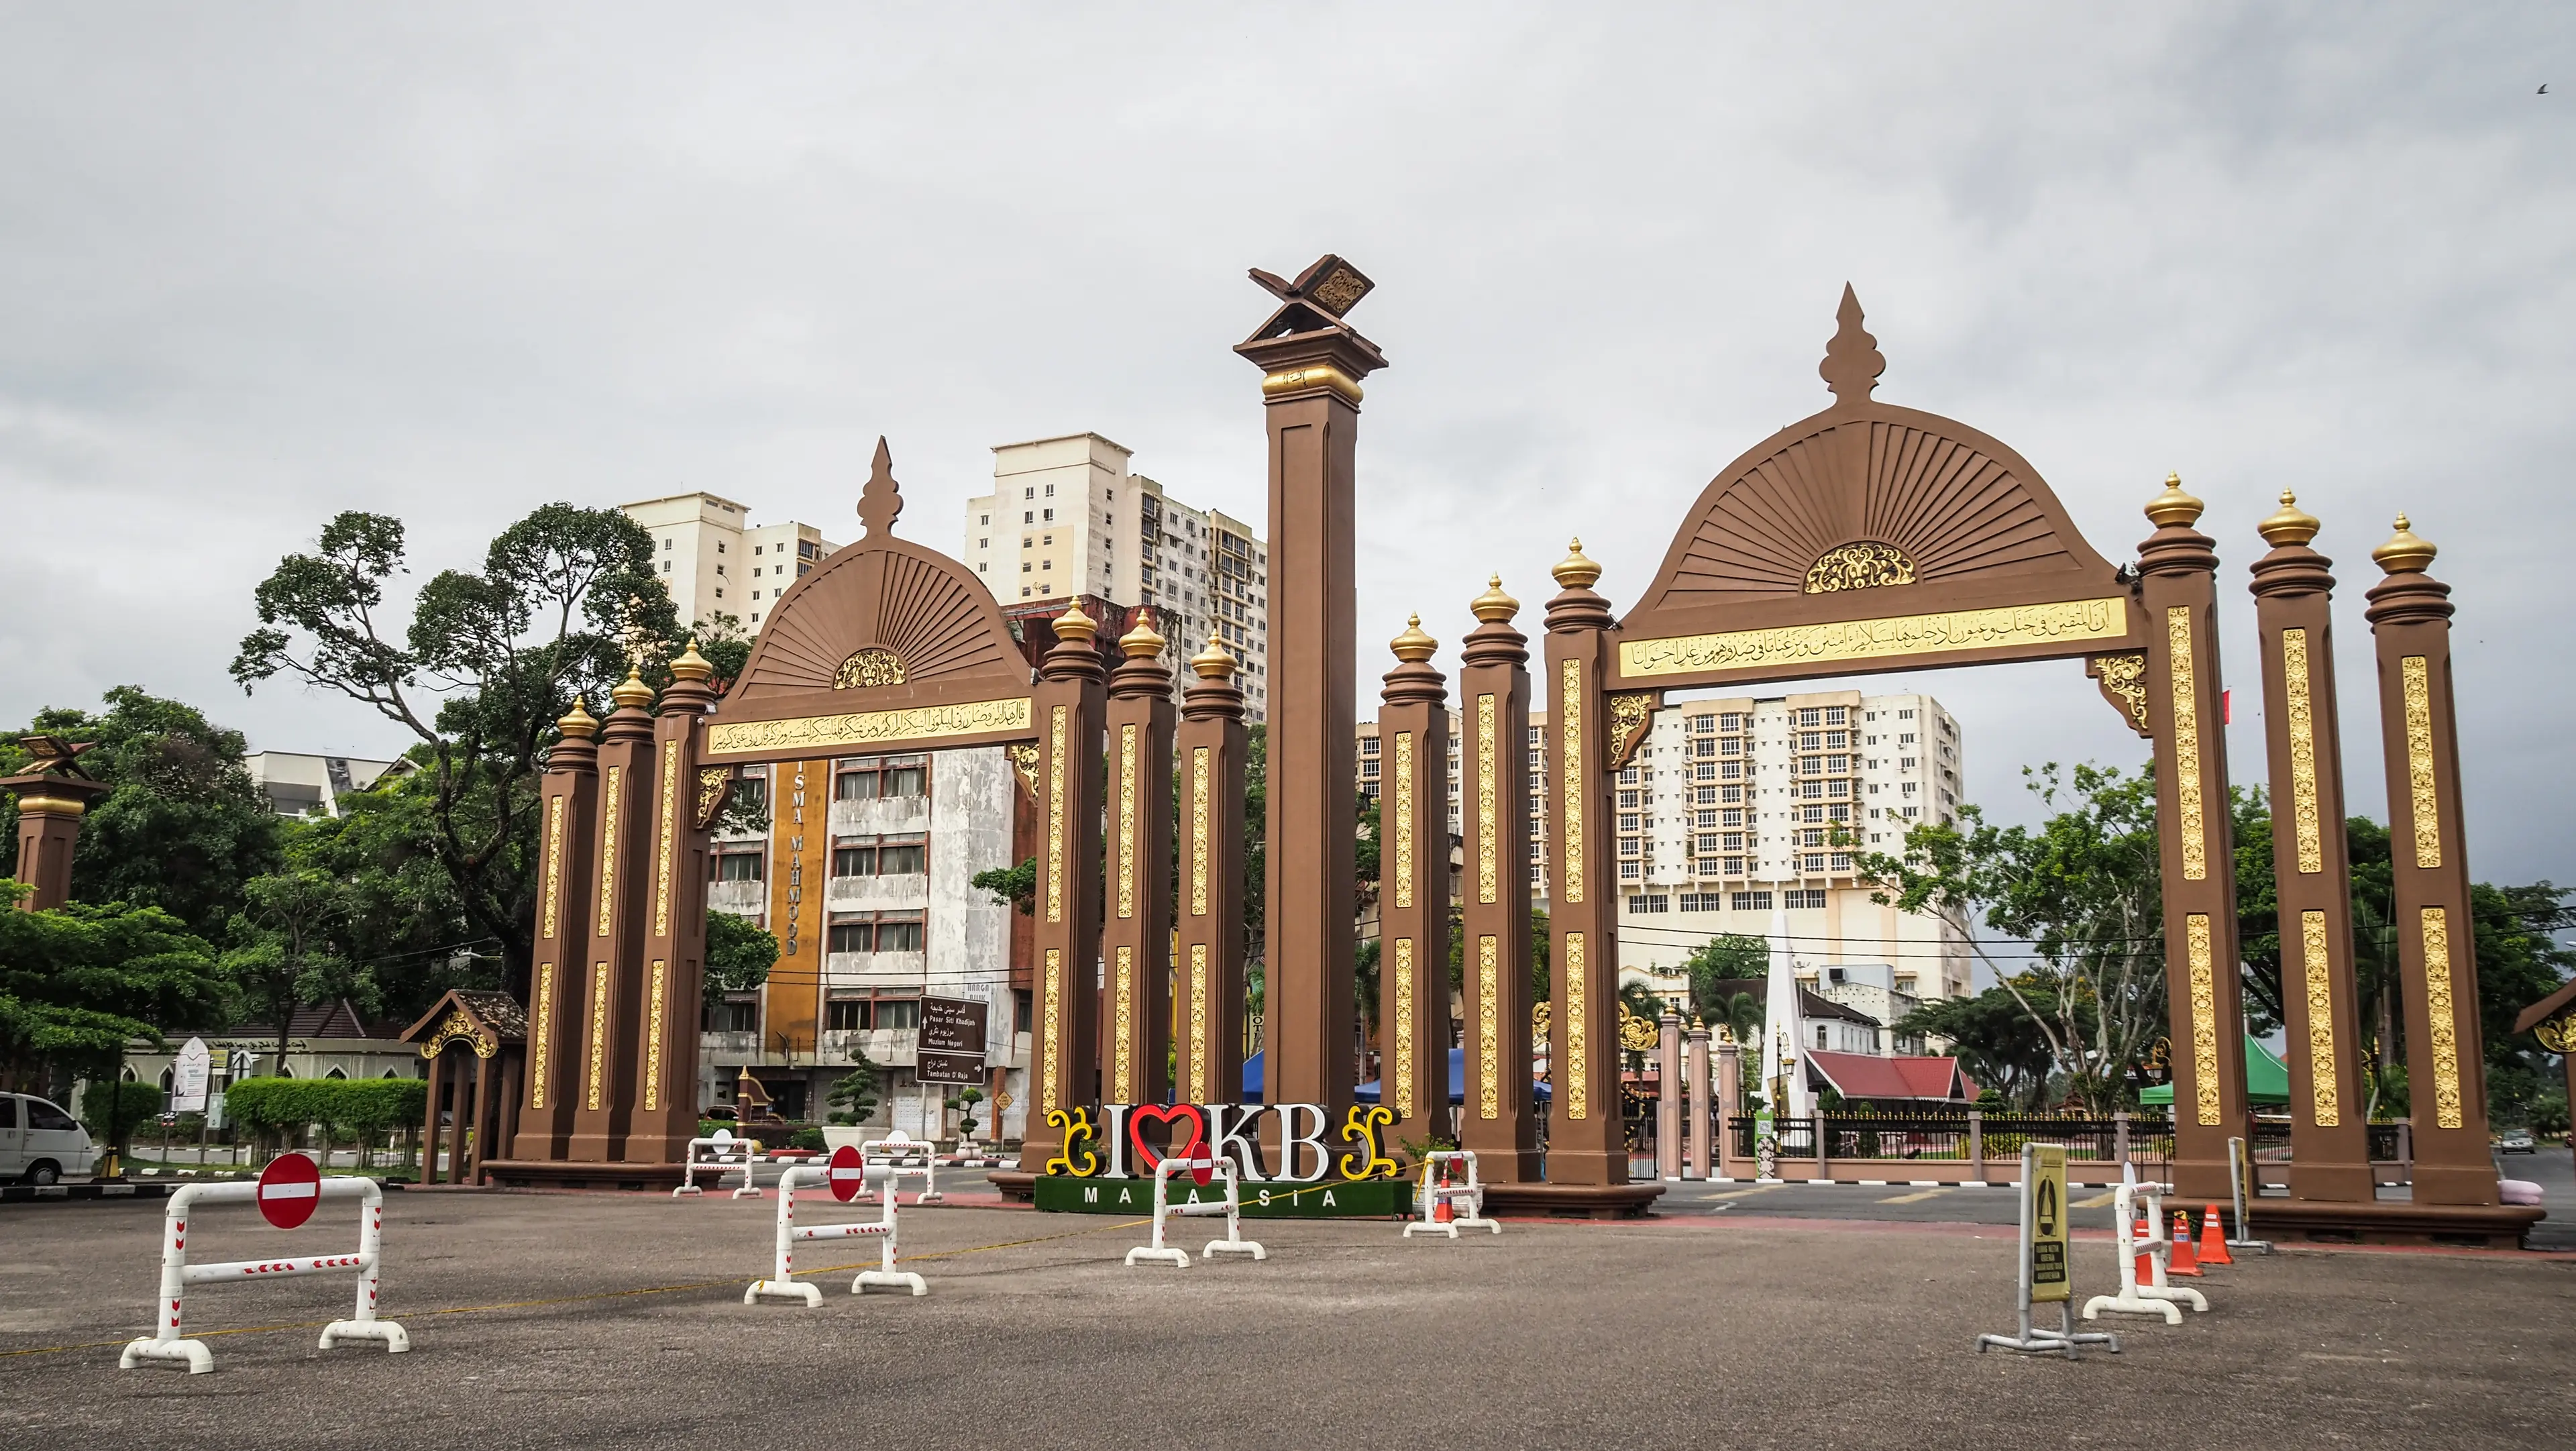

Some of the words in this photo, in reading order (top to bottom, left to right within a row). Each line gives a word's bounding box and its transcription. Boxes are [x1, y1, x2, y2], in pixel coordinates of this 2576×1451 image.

[787, 835, 804, 956] MAHMOOD
[929, 1015, 943, 1023] Pasar
[955, 1018, 975, 1026] Khadijah
[928, 1038, 946, 1046] Muzium
[947, 1039, 963, 1048] Negeri
[927, 1070, 951, 1078] Tambatan
[957, 1072, 968, 1080] Raja
[1104, 1104, 1130, 1179] I
[1203, 1104, 1332, 1181] KB
[1084, 1187, 1336, 1207] MAASIA
